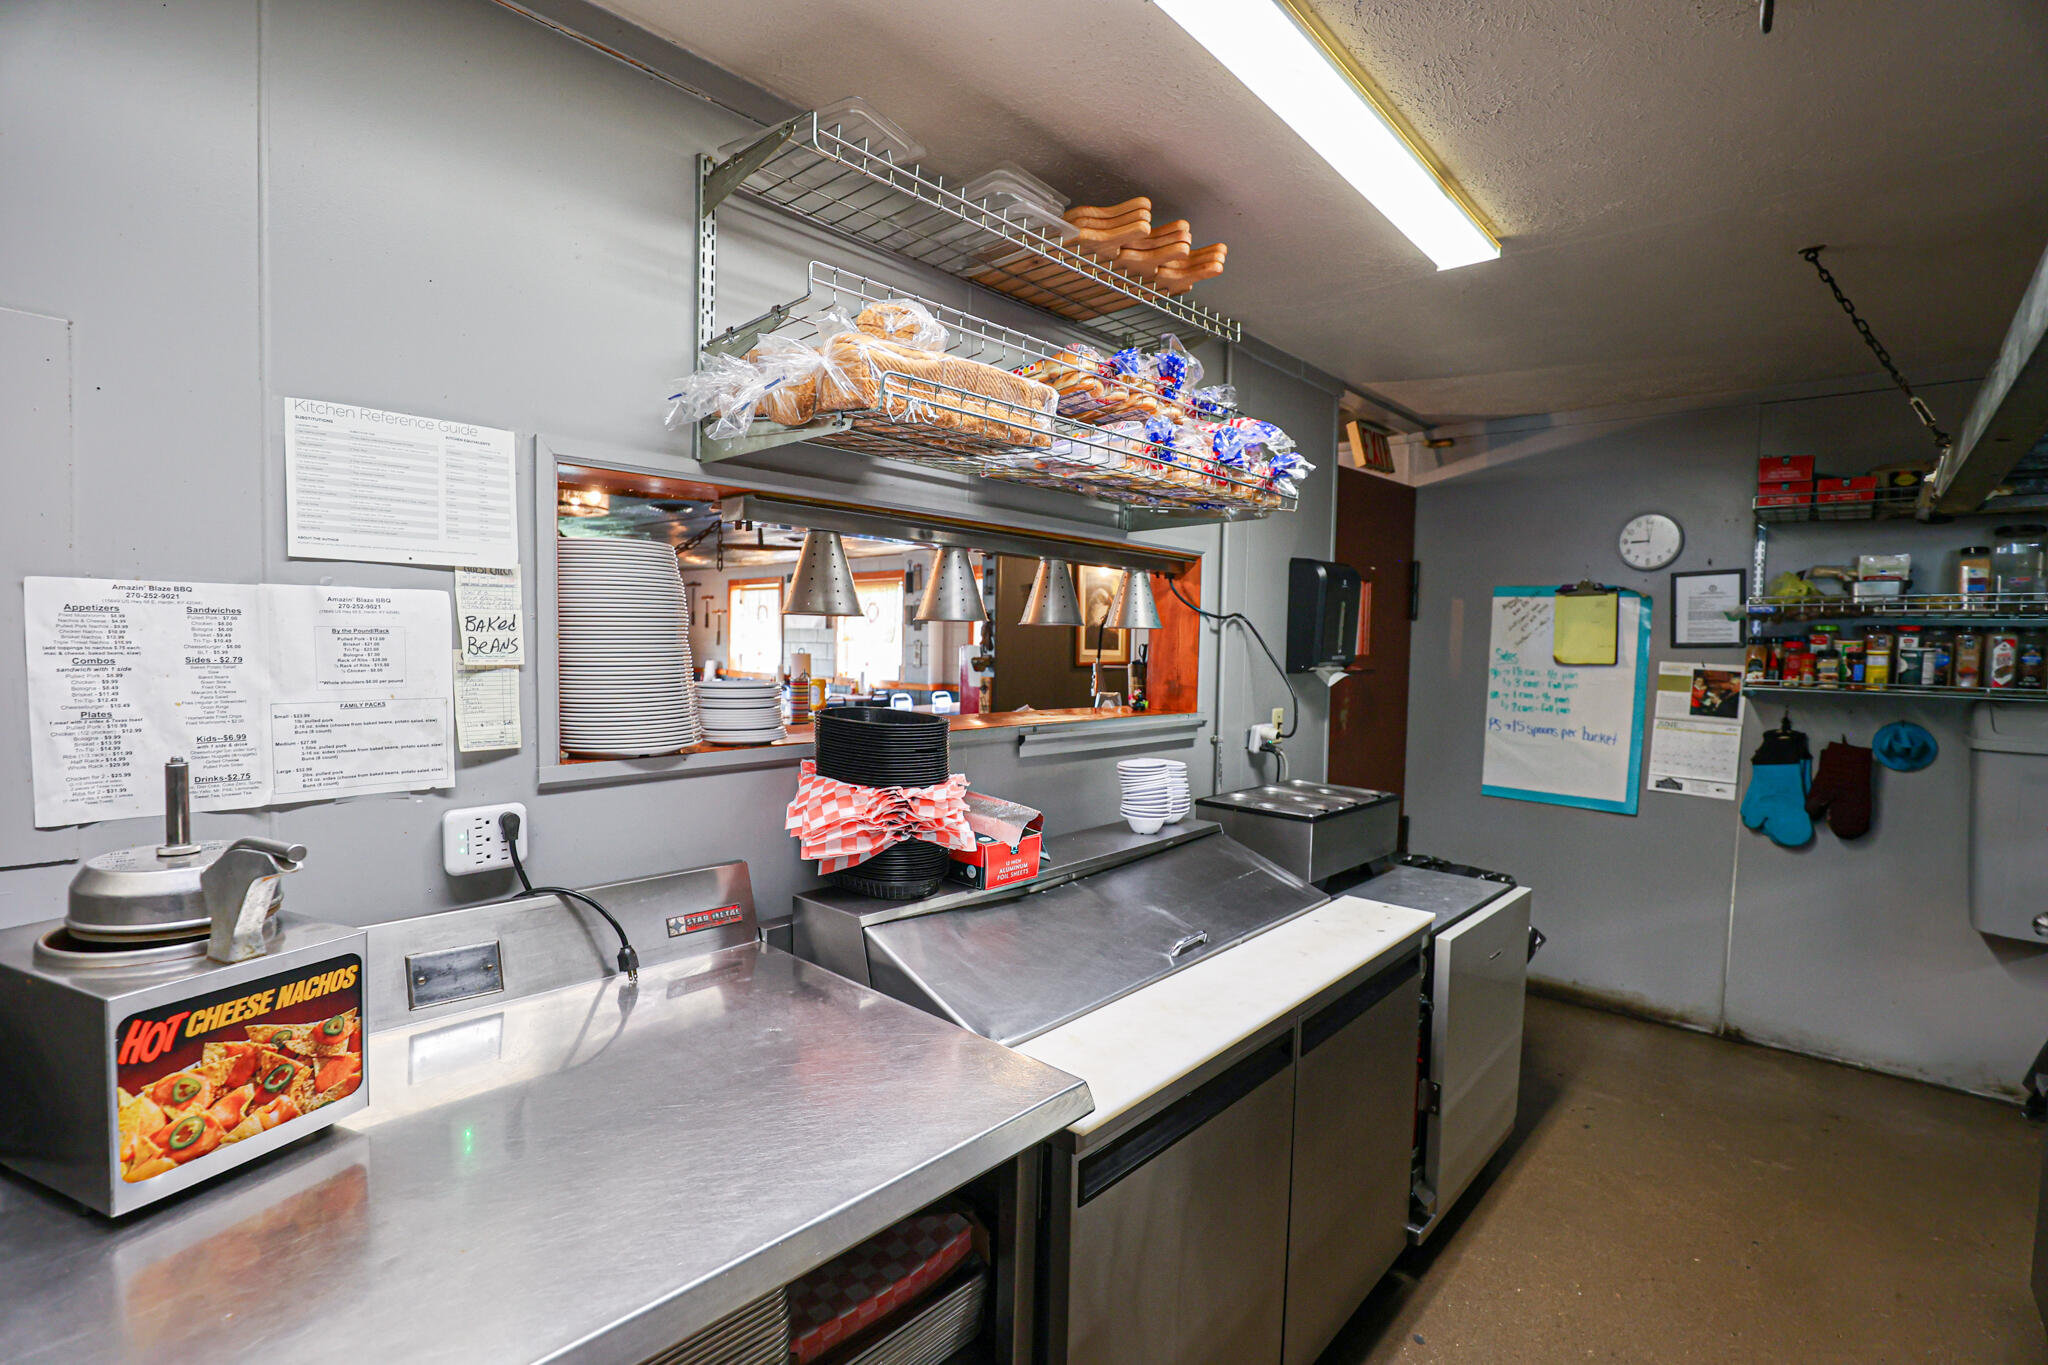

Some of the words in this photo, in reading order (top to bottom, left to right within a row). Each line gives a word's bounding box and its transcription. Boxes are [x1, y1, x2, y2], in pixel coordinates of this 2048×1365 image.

[294, 399, 355, 418] Kitchen
[360, 408, 434, 430] Reference
[438, 420, 478, 437] Guide
[296, 415, 333, 423] SUBSTITUTIONS
[1361, 428, 1392, 467] EXIT
[1488, 717, 1502, 731] PS
[1512, 719, 1525, 732] 15
[1526, 725, 1559, 737] spoons
[1561, 728, 1577, 740] per
[1582, 725, 1617, 745] bucket
[194, 773, 251, 784] Drinks-$2.75
[999, 863, 1029, 874] ALUMINUM
[1010, 869, 1028, 878] SHEETS
[117, 1011, 192, 1065] HOT
[185, 988, 278, 1038] CHEESE
[274, 964, 359, 1011] NACHOS
